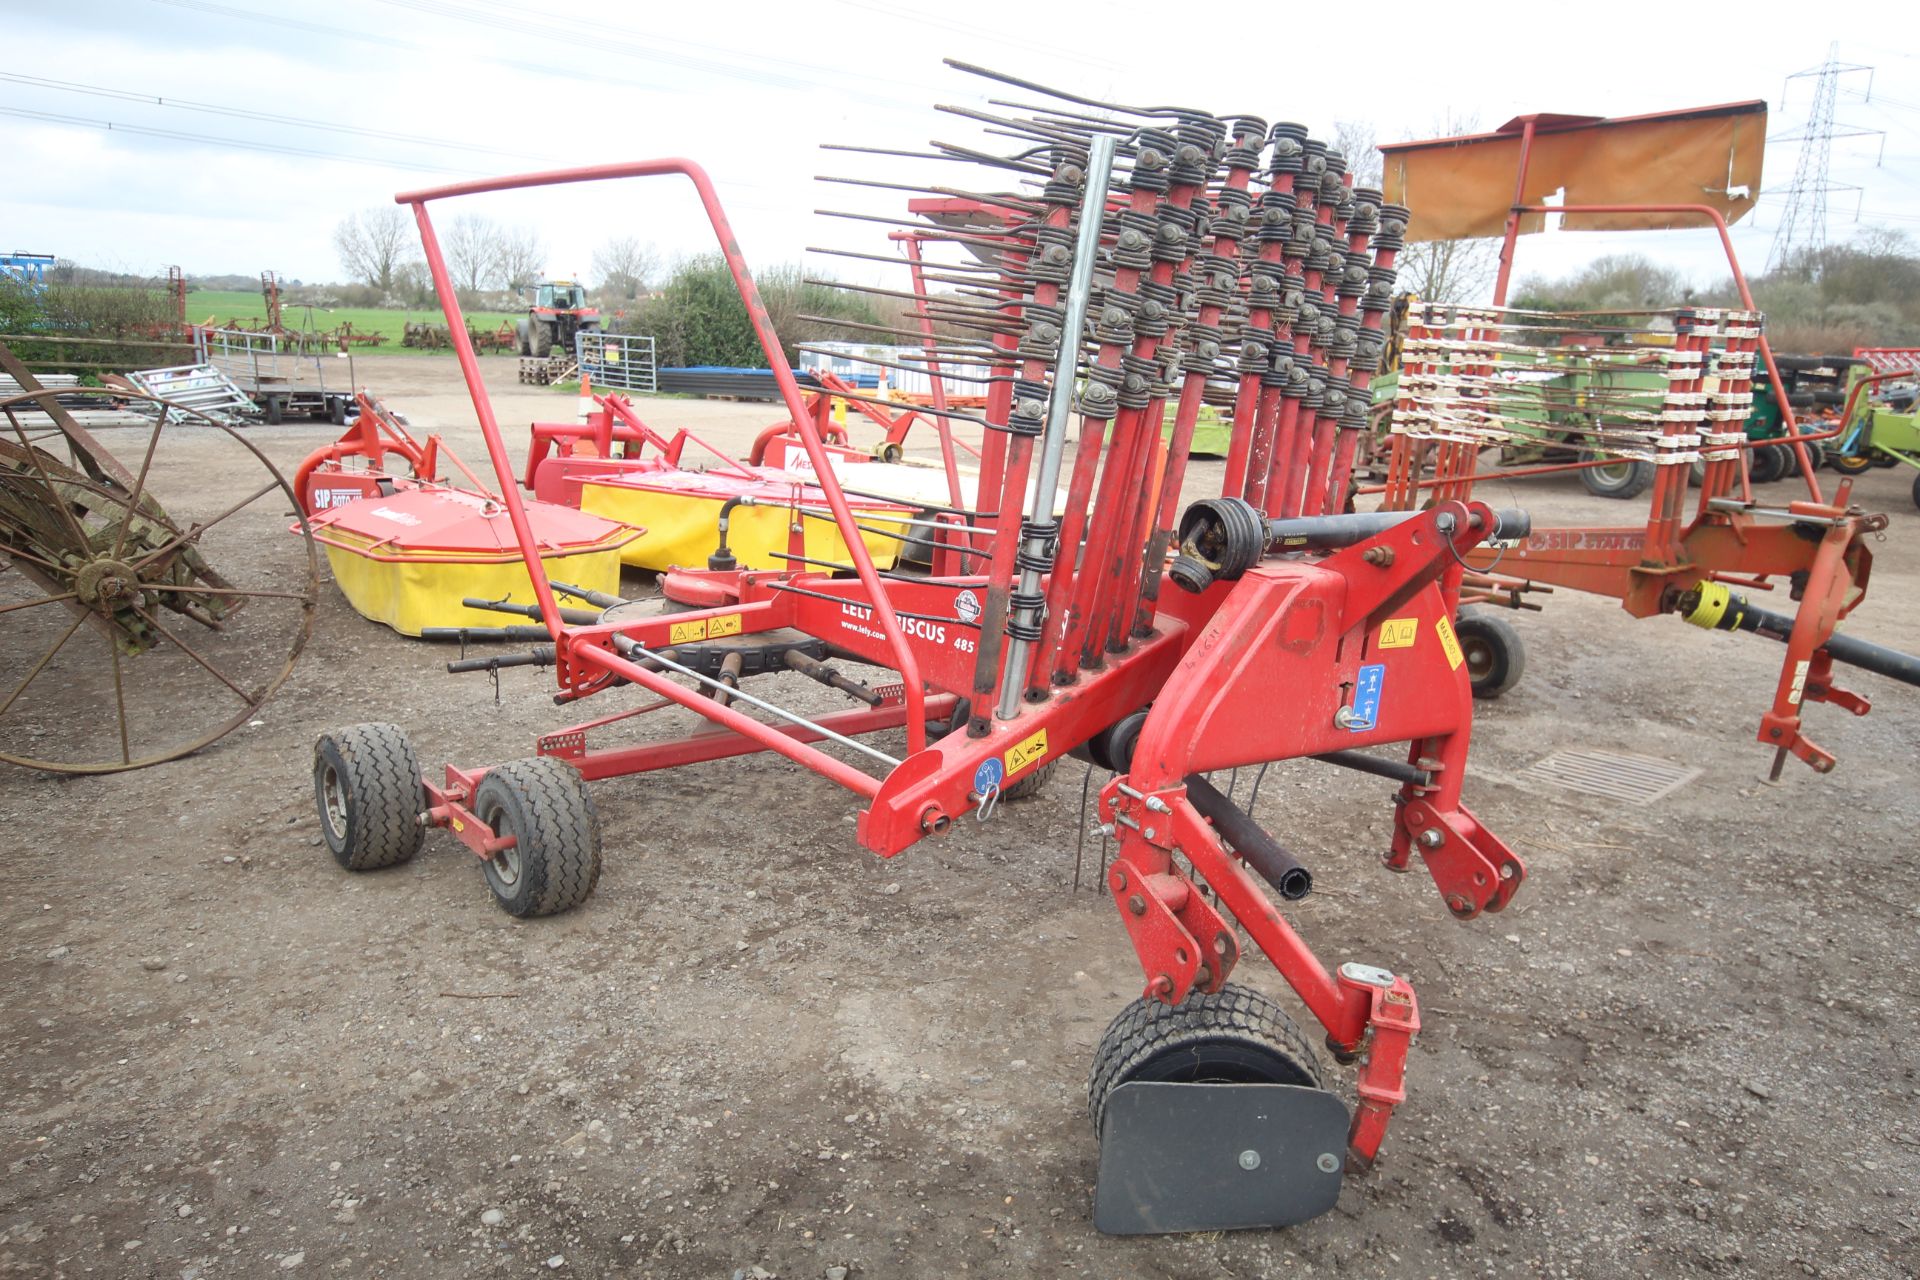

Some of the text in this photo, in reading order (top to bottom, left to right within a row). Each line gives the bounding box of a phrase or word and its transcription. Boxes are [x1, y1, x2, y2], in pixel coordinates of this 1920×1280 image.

[314, 489, 330, 508] SIP
[1547, 532, 1582, 549] SIP
[841, 621, 886, 641] www.lely.com
[842, 603, 873, 621] LELY
[954, 638, 974, 653] 485
